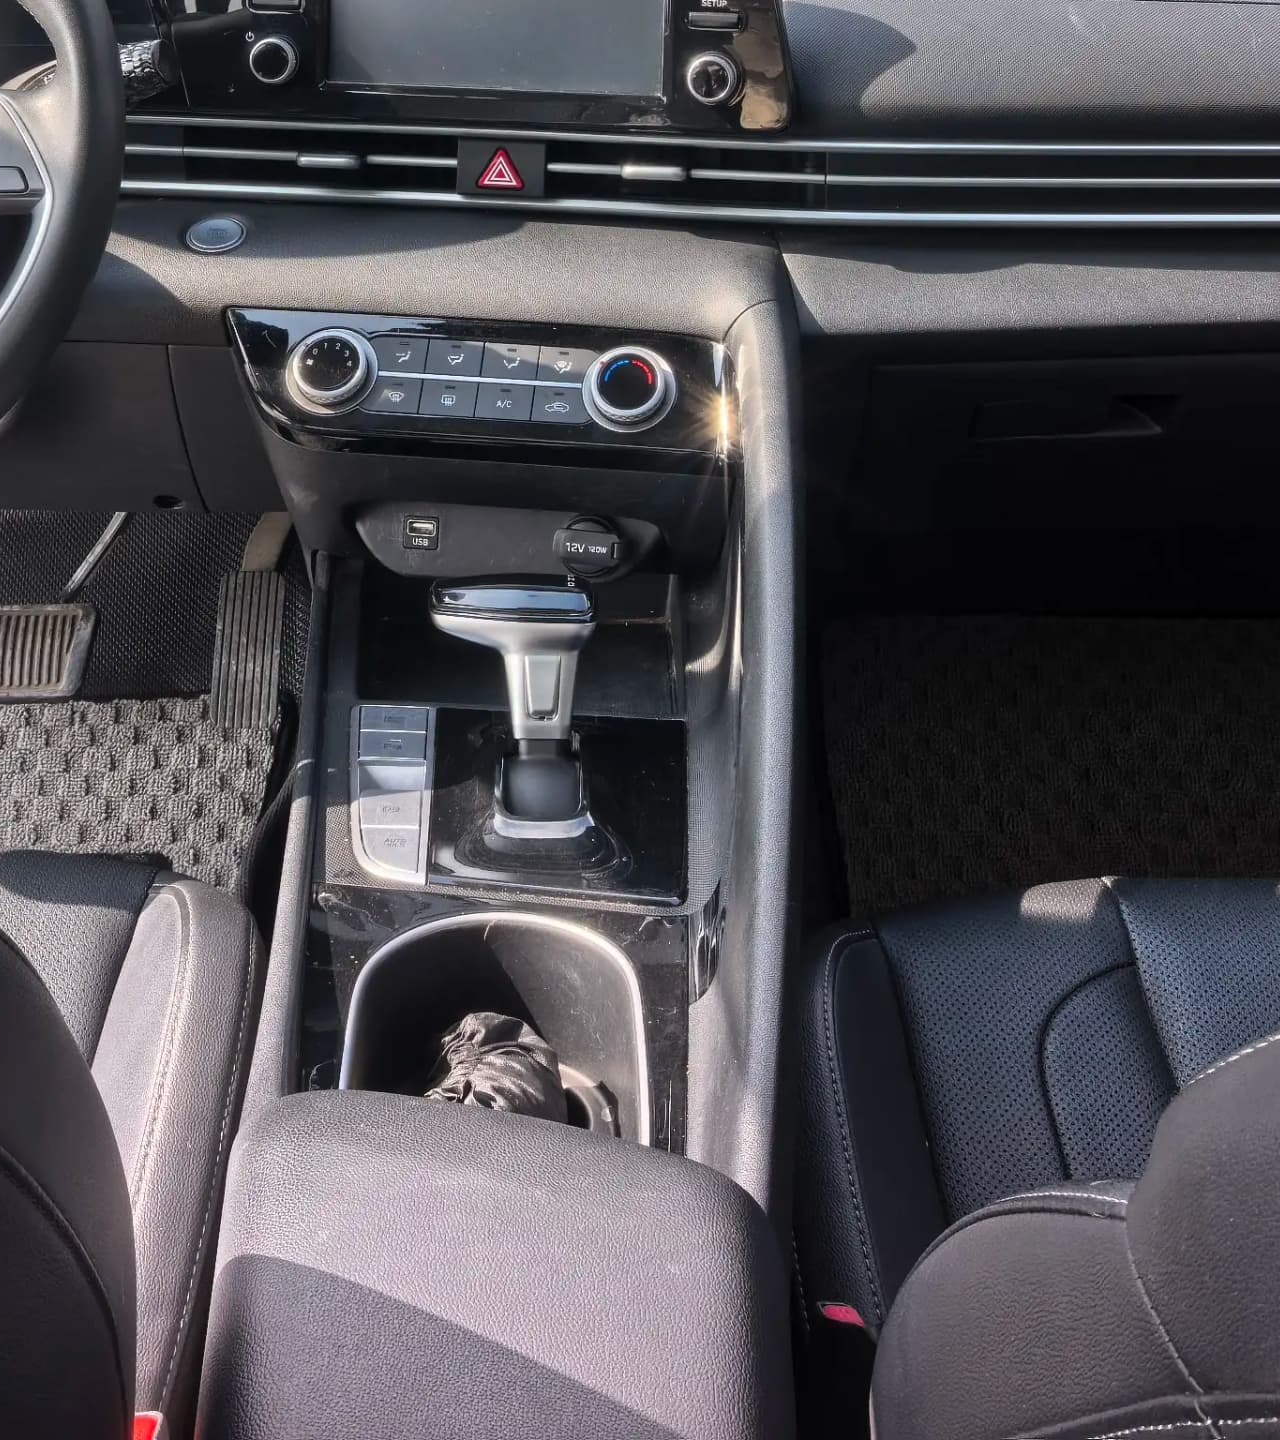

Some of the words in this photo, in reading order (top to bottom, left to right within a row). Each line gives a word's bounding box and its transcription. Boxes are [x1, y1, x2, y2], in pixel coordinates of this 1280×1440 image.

[701, 0, 728, 7] SETUP
[495, 399, 513, 409] A/C
[412, 537, 429, 547] USB
[565, 542, 586, 553] 12V
[588, 545, 608, 554] 120W
